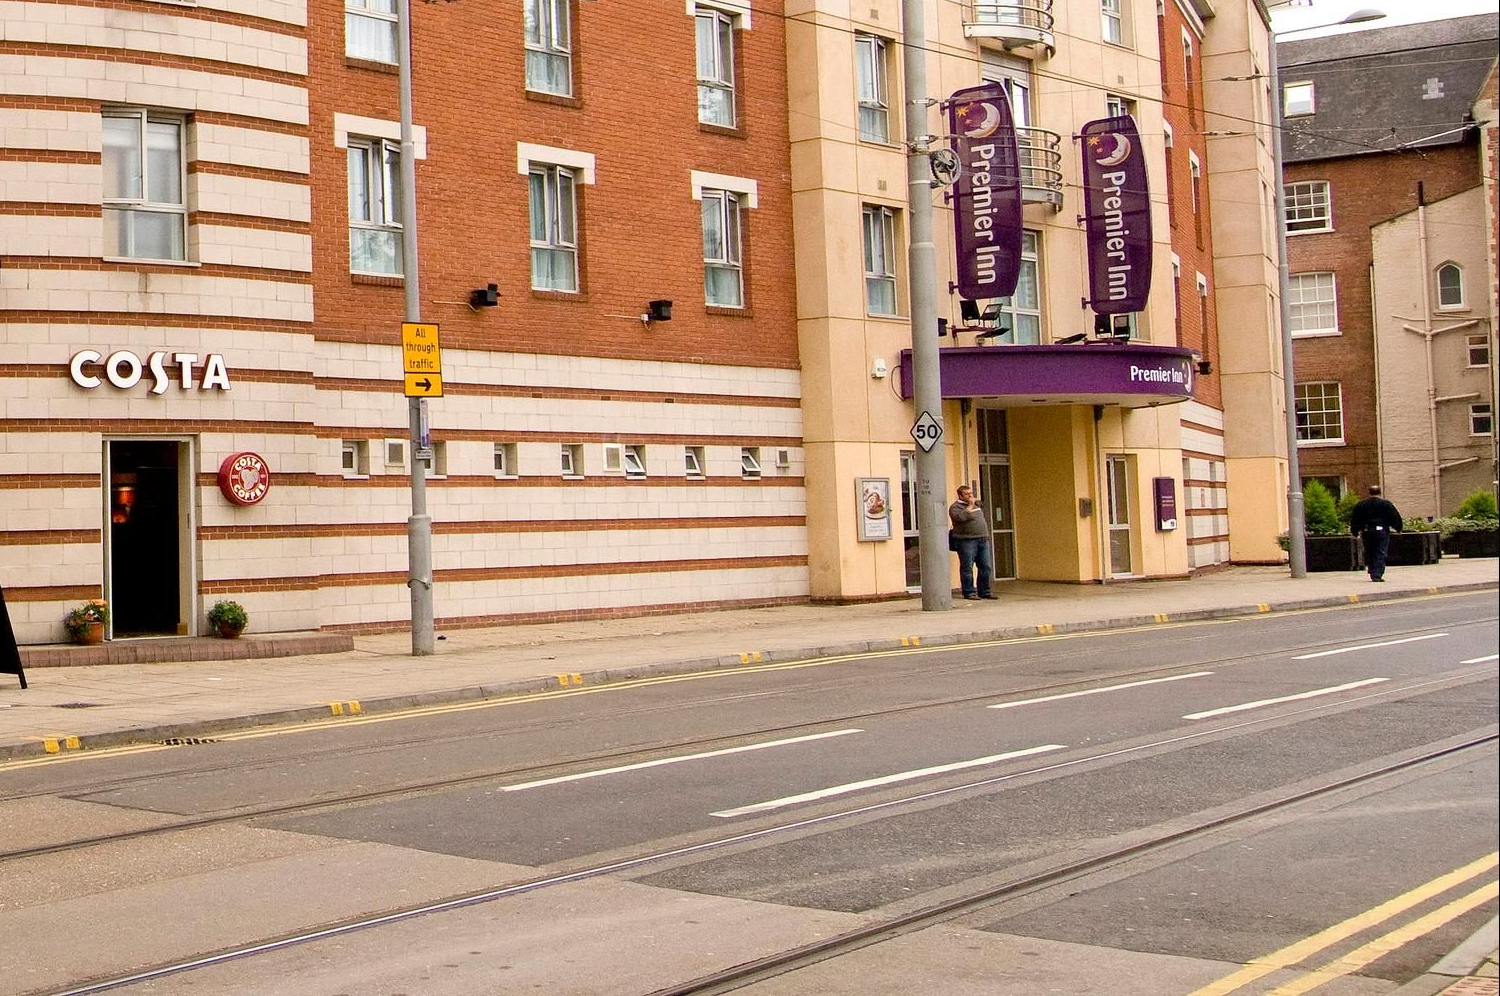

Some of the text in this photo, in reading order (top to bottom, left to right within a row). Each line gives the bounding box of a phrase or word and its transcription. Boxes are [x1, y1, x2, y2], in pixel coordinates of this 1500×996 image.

[971, 143, 1000, 285] Premier Inn
[1102, 171, 1132, 301] Premier Inn
[415, 327, 426, 338] All
[406, 342, 436, 354] through
[409, 358, 434, 369] traffic
[69, 350, 231, 395] COSTA
[1130, 365, 1184, 383] Premier Inn
[916, 424, 938, 440] 50
[234, 456, 262, 472] COSTA
[233, 482, 266, 500] COFFEE
